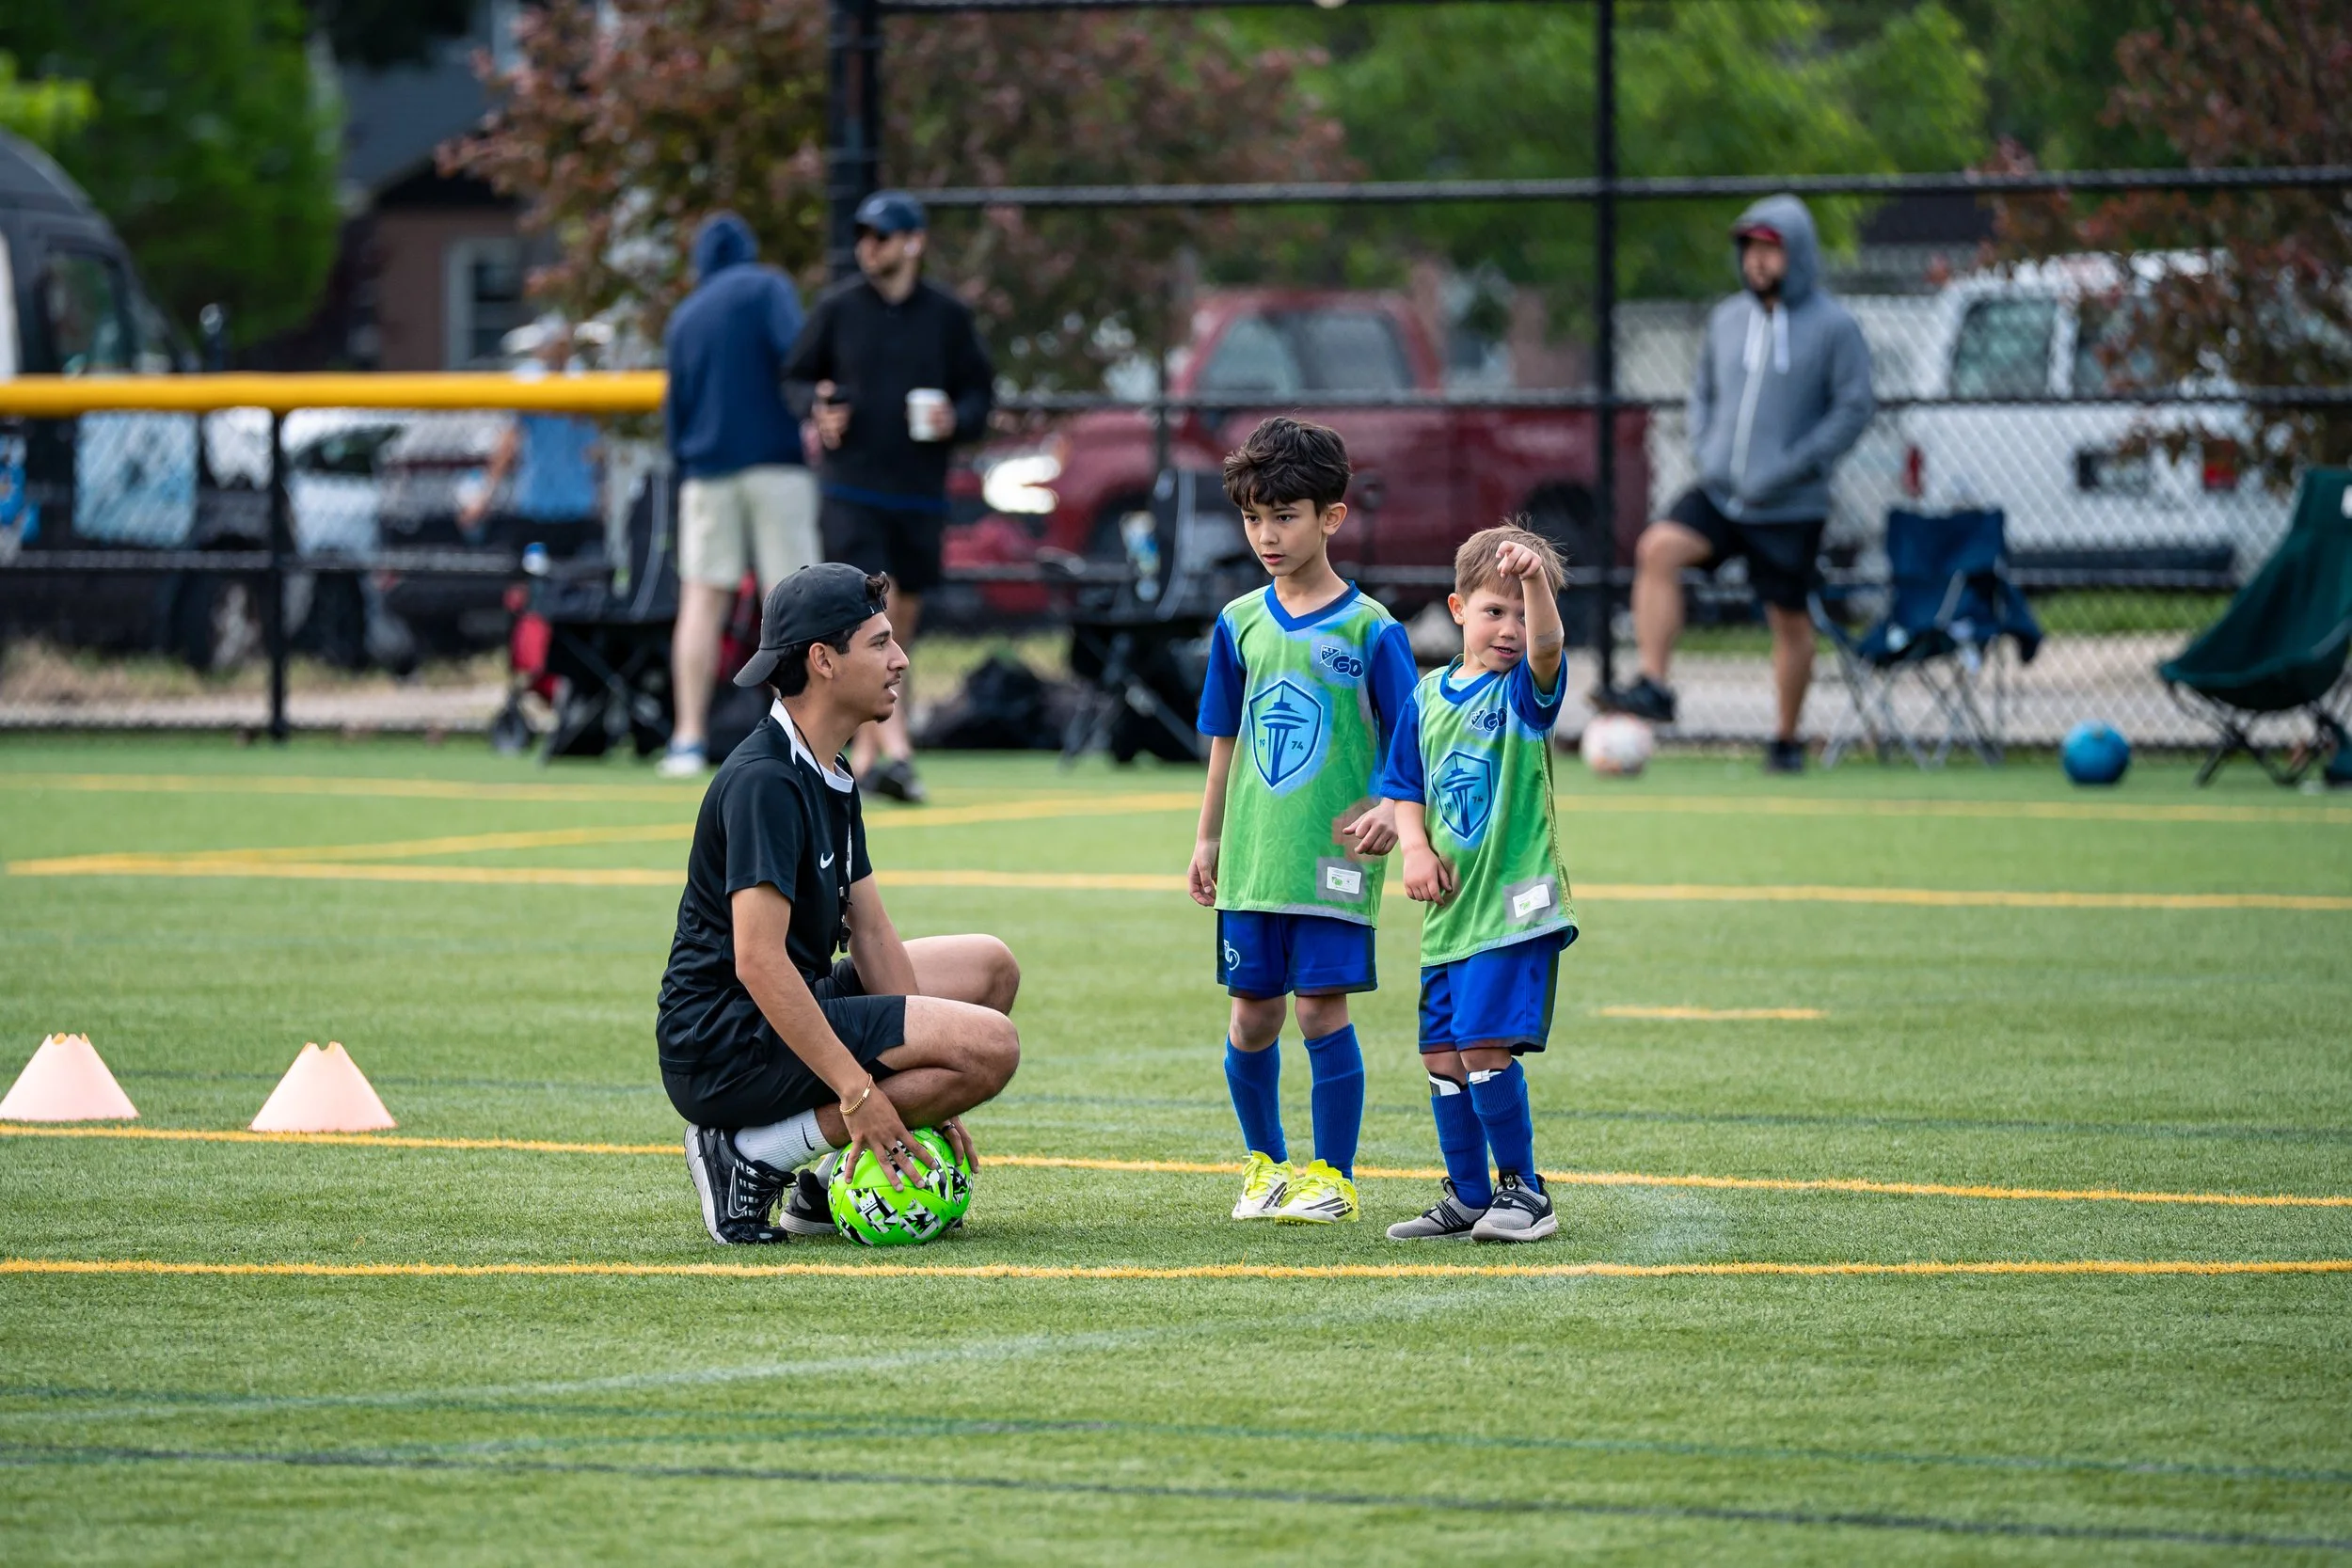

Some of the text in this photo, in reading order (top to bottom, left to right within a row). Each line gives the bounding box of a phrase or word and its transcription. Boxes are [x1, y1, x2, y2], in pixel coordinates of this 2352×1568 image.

[1332, 655, 1364, 678] GO
[1483, 707, 1507, 731] GO
[1292, 741, 1304, 751] 74
